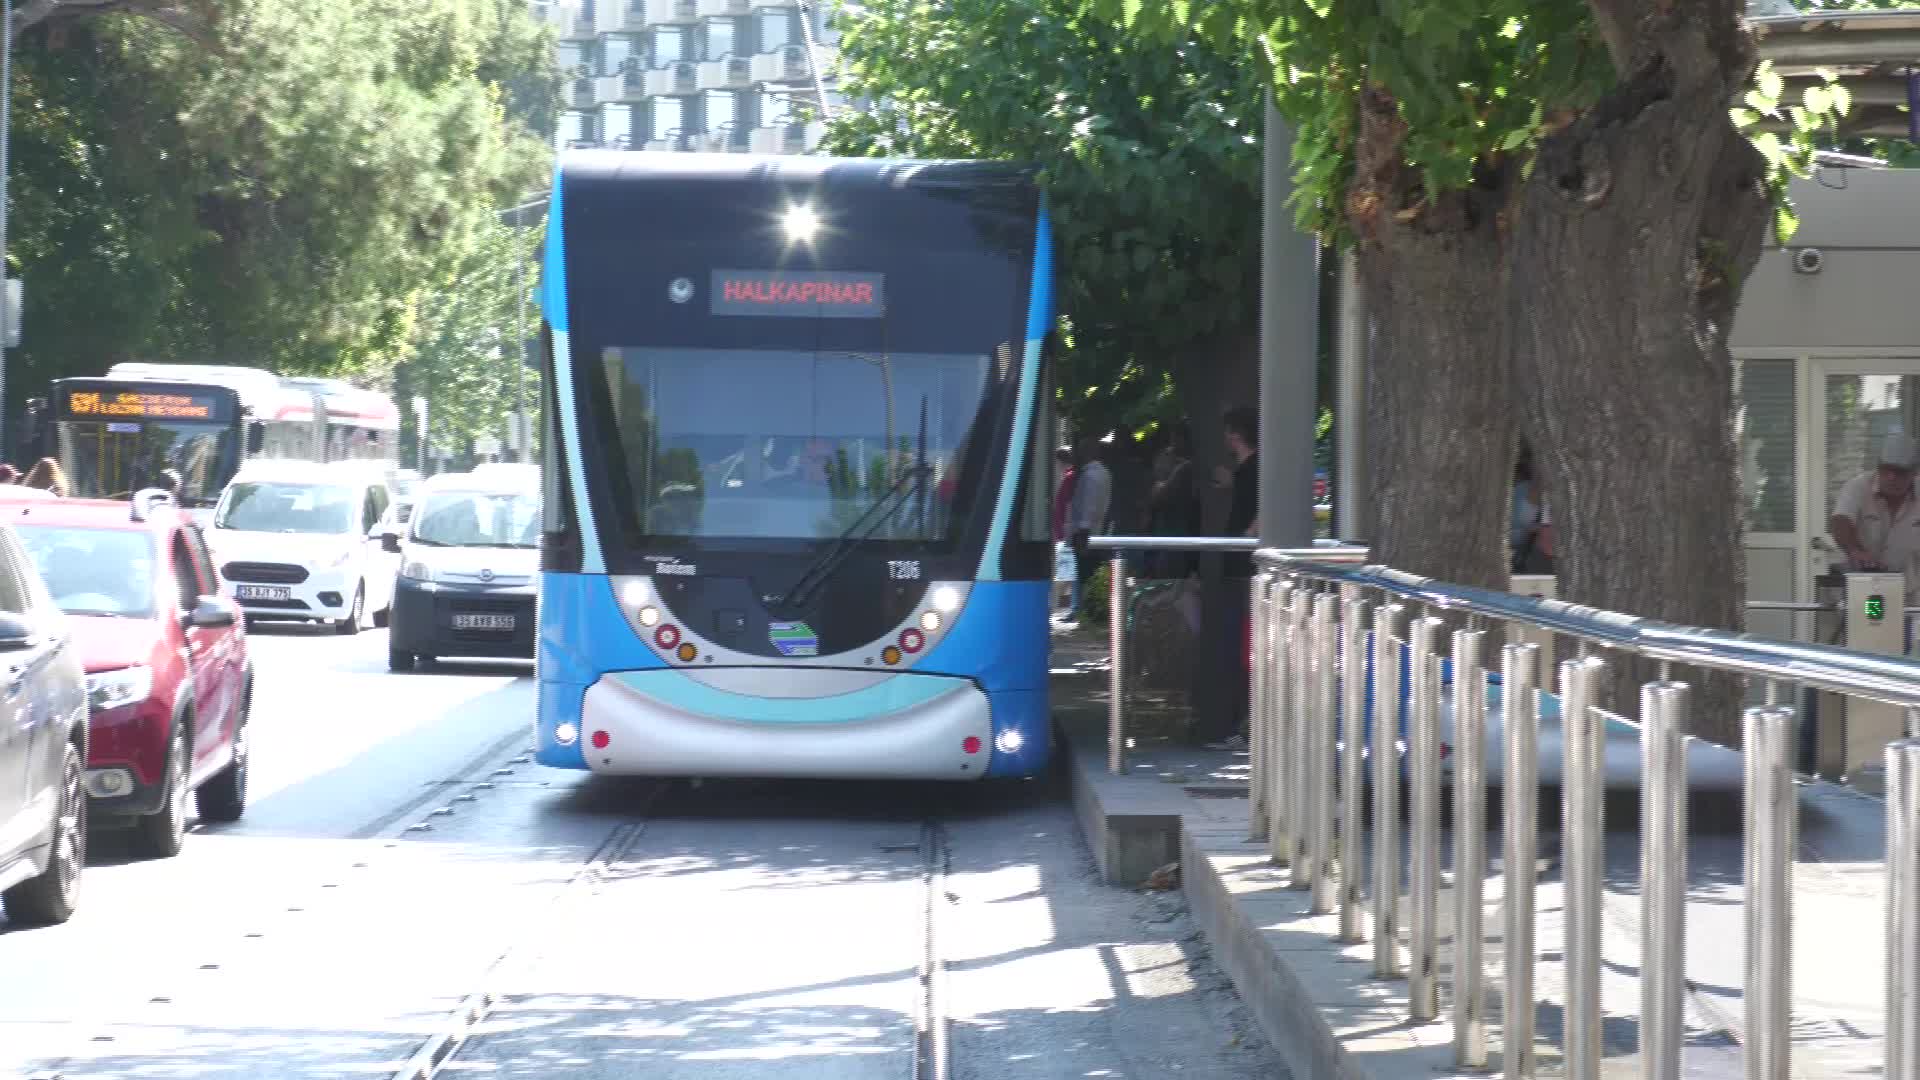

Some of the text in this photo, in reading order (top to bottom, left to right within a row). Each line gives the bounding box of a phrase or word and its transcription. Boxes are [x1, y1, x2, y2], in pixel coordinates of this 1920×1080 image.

[724, 281, 873, 303] HALKAPINAR
[655, 562, 696, 575] Rotem
[887, 560, 920, 580] T206
